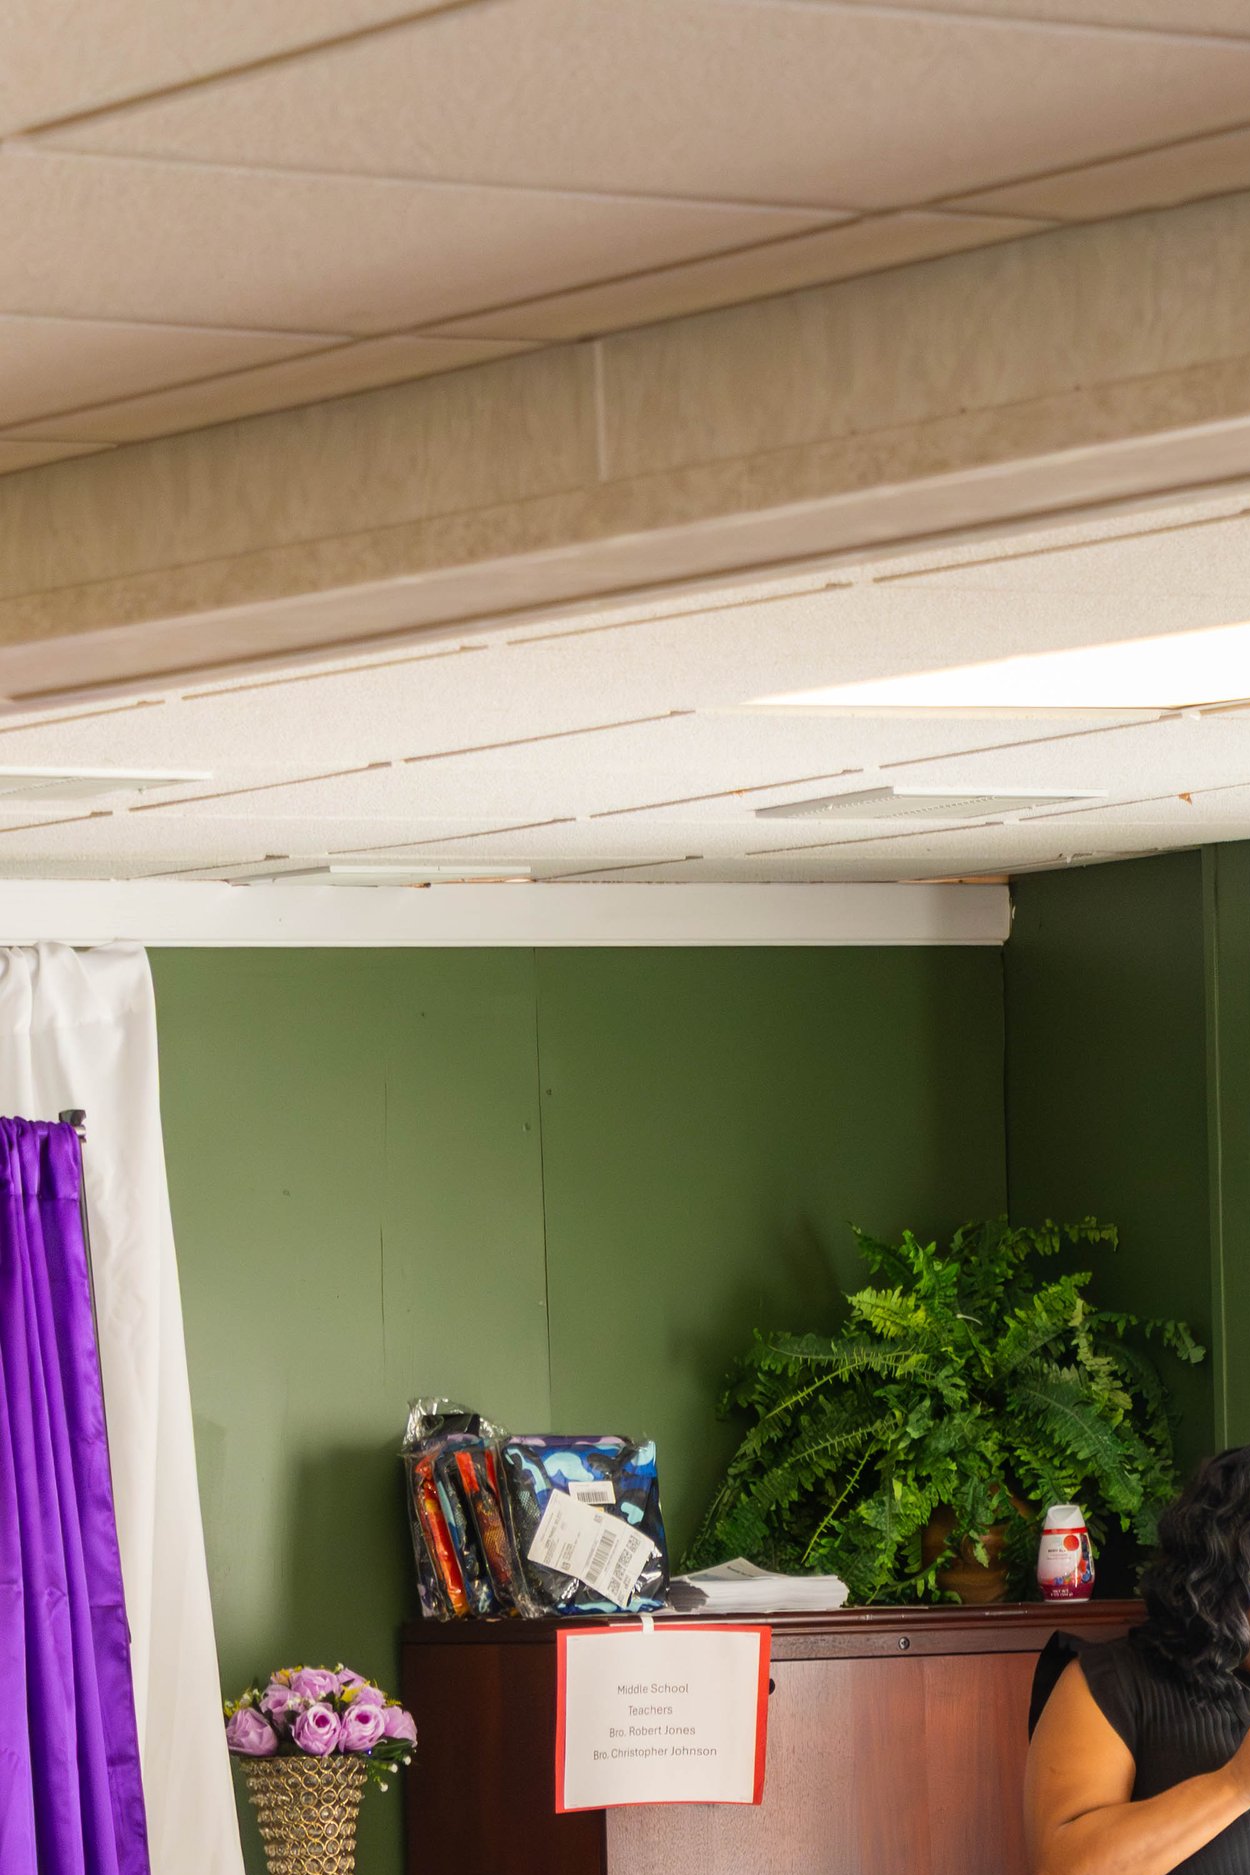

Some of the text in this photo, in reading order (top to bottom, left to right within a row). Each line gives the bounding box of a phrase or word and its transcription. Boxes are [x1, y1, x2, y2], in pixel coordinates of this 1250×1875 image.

[617, 1683, 689, 1695] Middle School
[628, 1705, 673, 1716] Teachers
[609, 1725, 696, 1738] Bro. Robert Jones
[593, 1746, 717, 1760] Bro. Christopher Johnson
